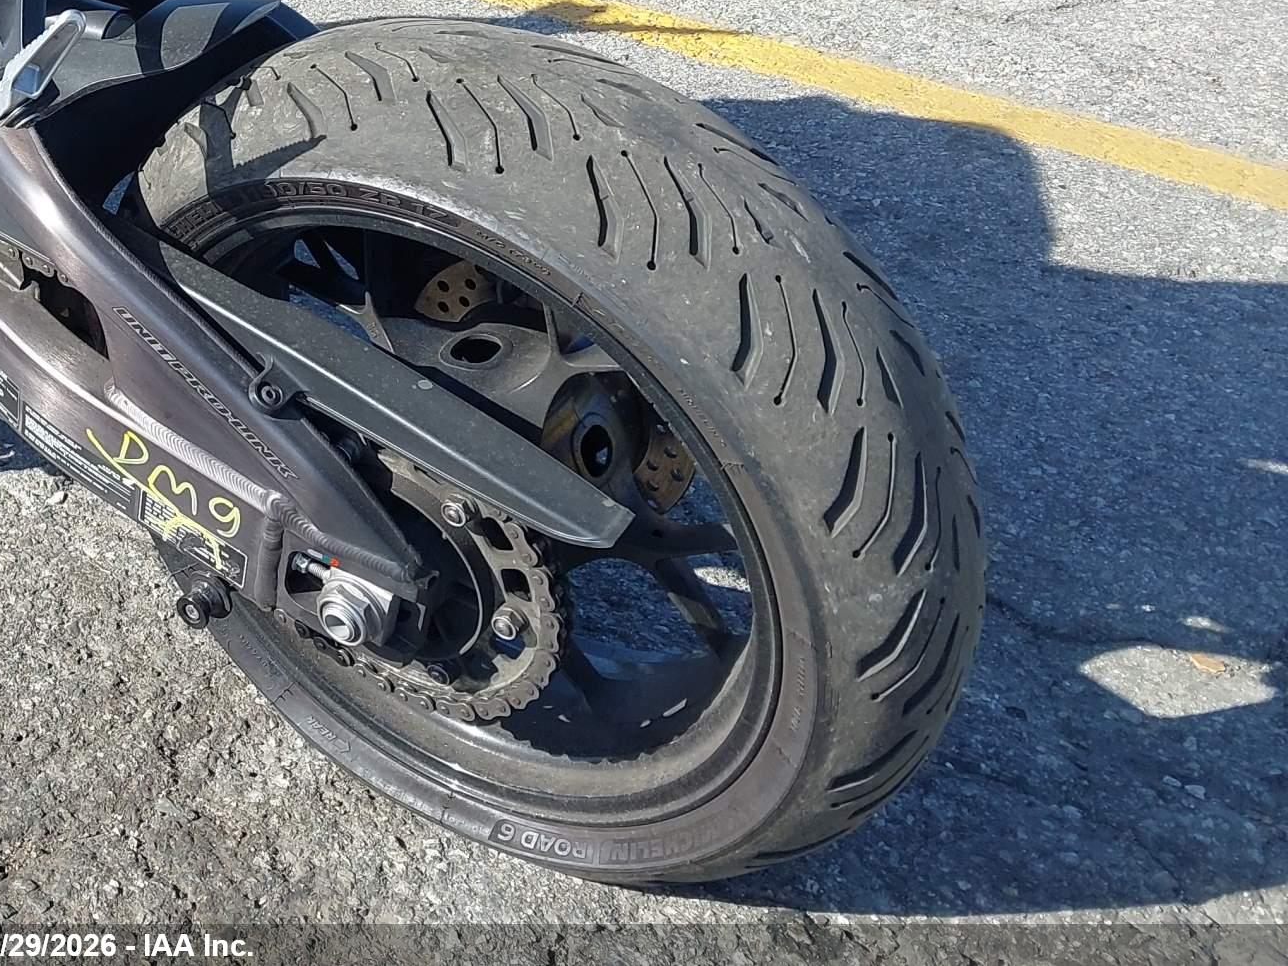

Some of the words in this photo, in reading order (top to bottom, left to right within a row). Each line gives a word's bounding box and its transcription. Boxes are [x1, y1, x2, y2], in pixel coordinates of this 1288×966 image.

[112, 306, 176, 361] UNIT
[168, 358, 300, 481] PRO-LINK
[497, 822, 517, 842] 6
[520, 829, 590, 860] ROAD
